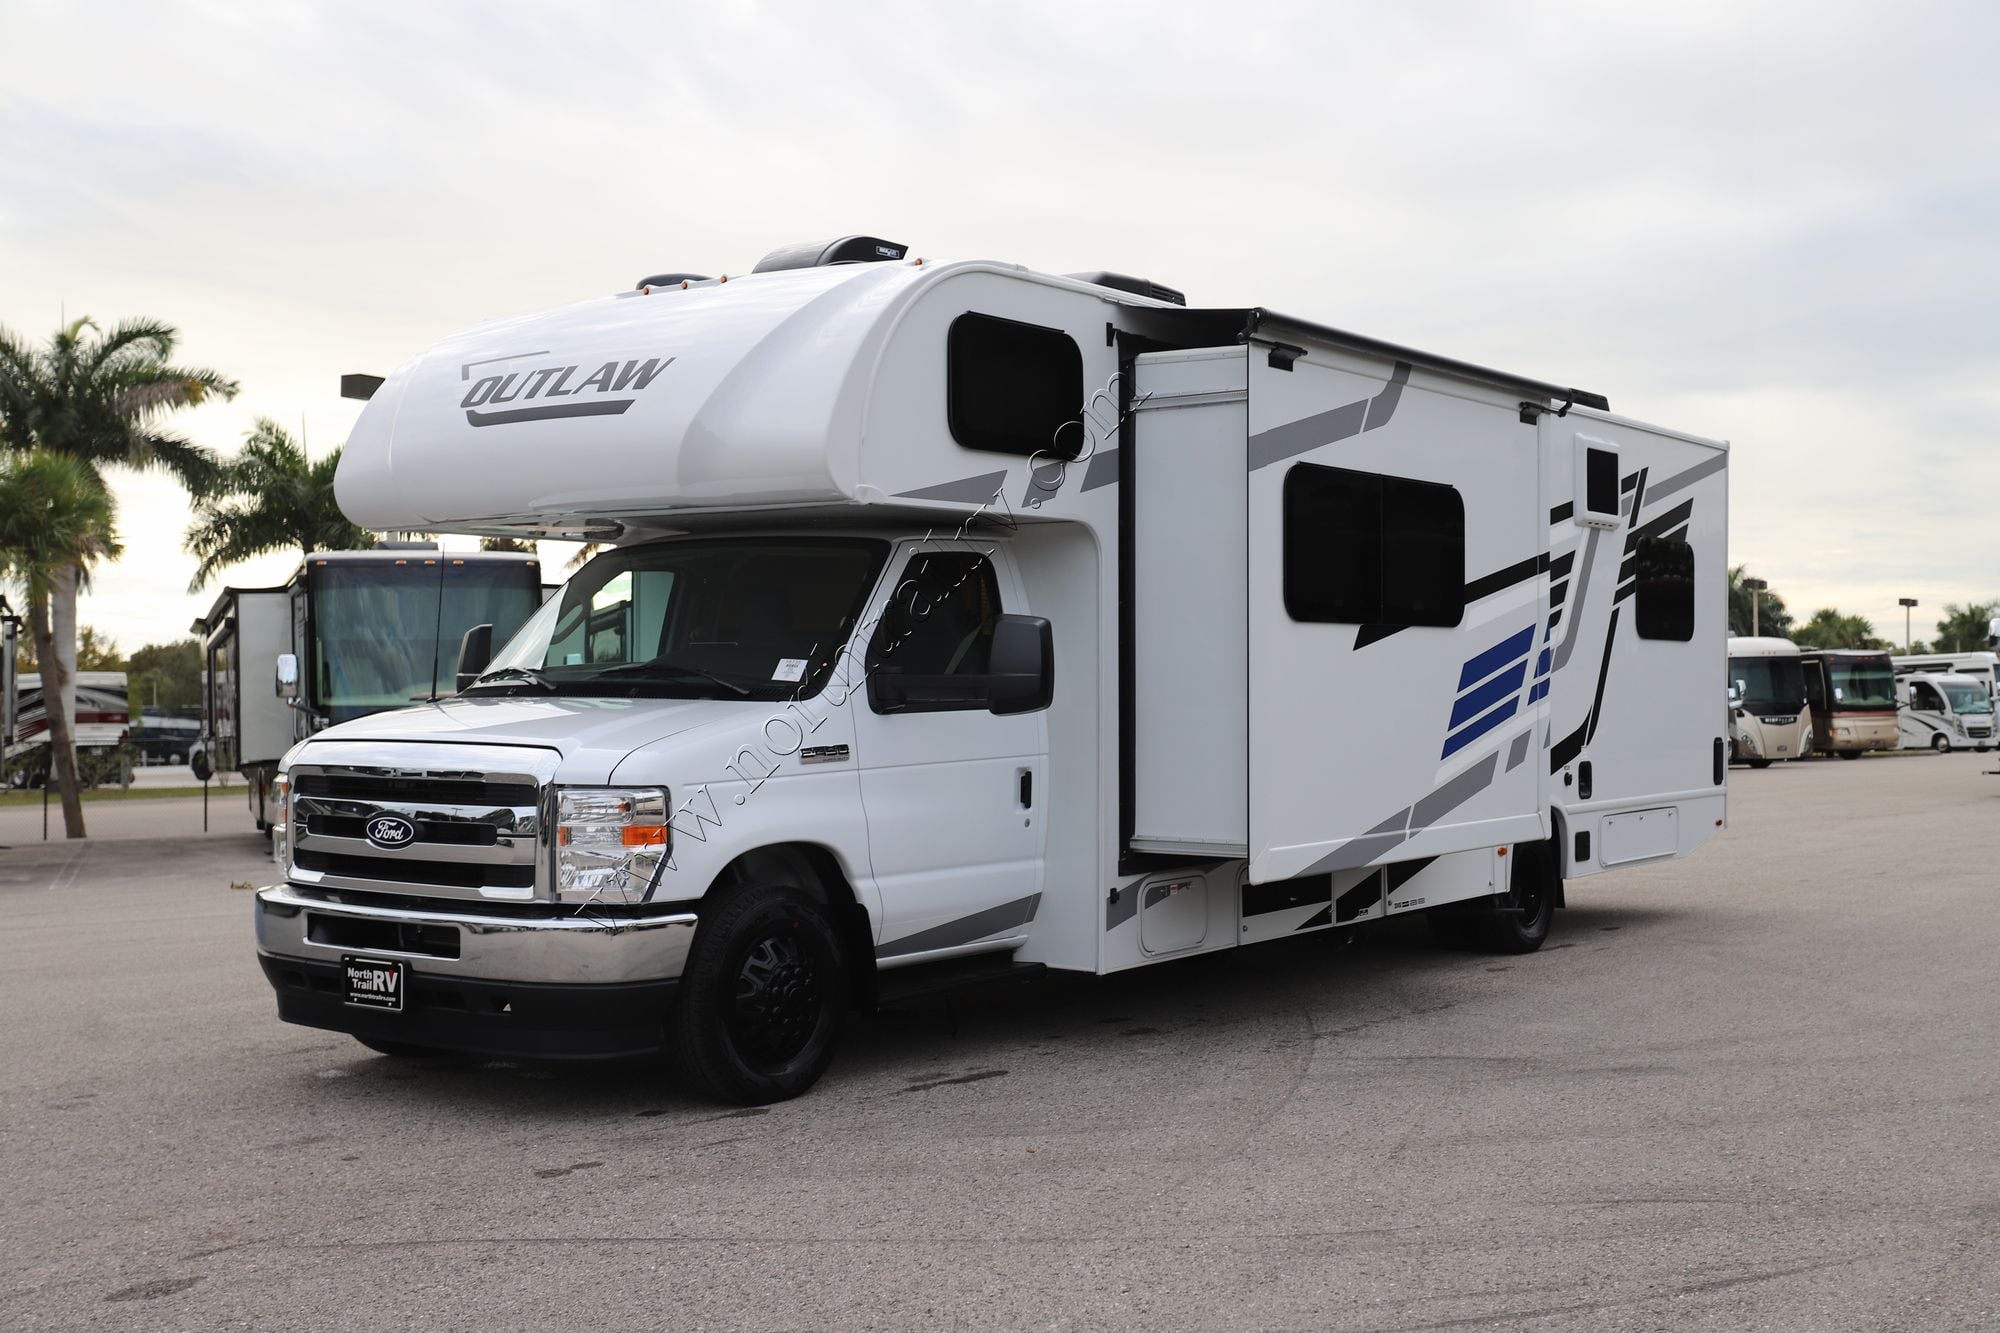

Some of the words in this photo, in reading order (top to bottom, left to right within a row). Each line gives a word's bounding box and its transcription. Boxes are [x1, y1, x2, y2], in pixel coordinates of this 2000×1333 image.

[460, 356, 677, 409] OUTLAW
[375, 820, 404, 840] Ford
[347, 967, 372, 979] North
[373, 970, 398, 992] RV
[352, 978, 372, 990] Trail
